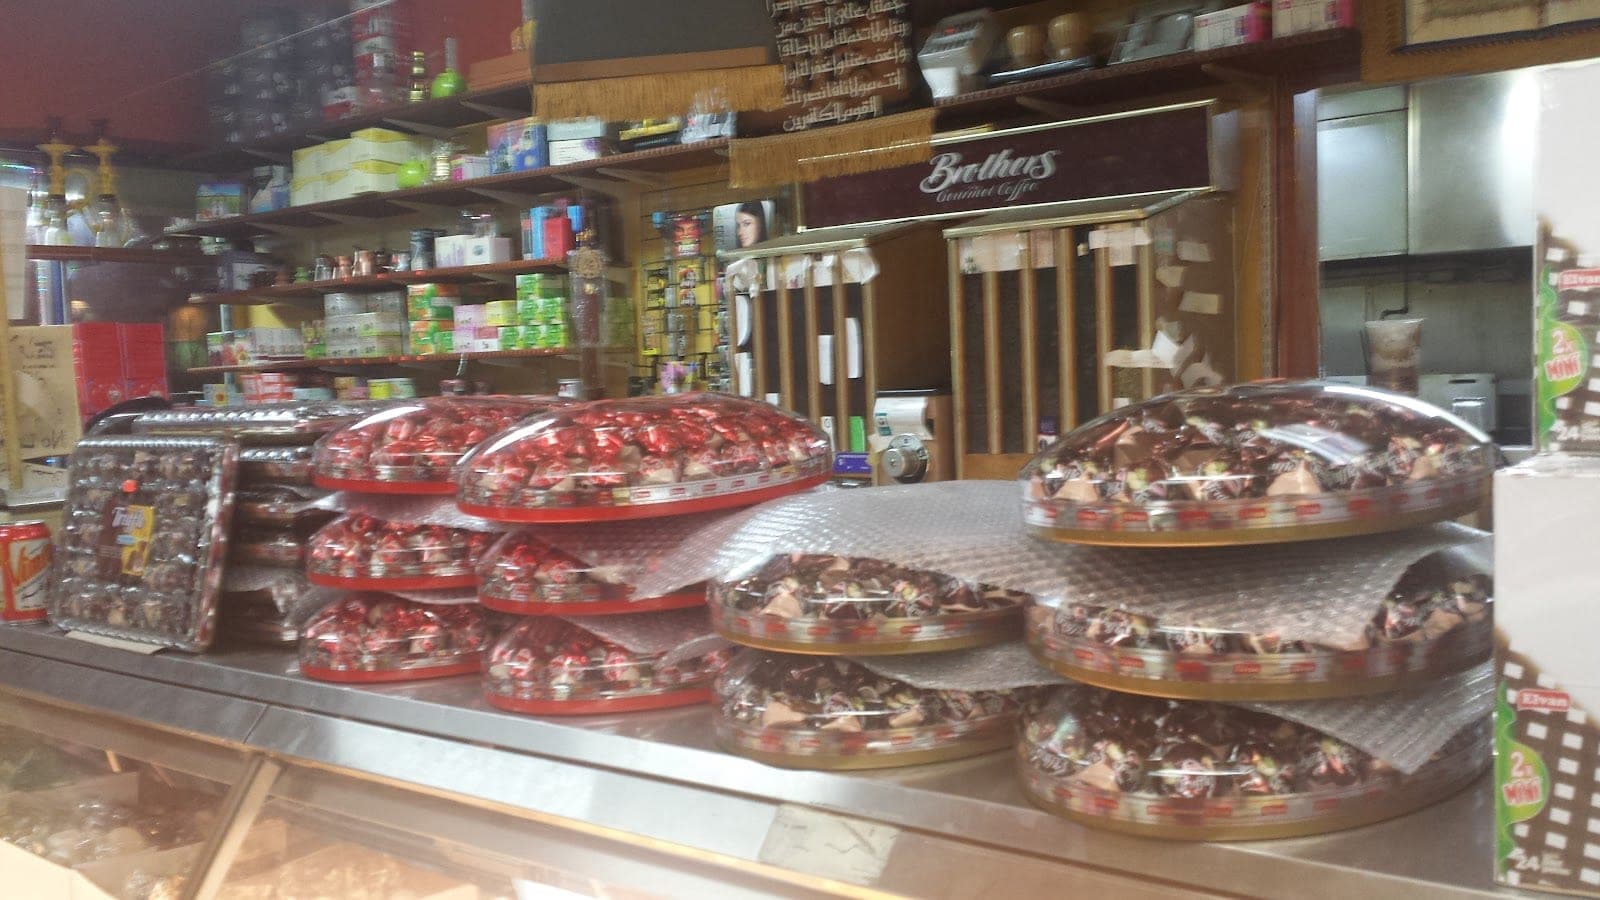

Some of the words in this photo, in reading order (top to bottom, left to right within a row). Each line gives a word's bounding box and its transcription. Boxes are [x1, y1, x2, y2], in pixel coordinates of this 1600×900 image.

[919, 148, 1060, 193] Brothers
[936, 183, 994, 203] Gourmet
[996, 179, 1038, 202] Coffee
